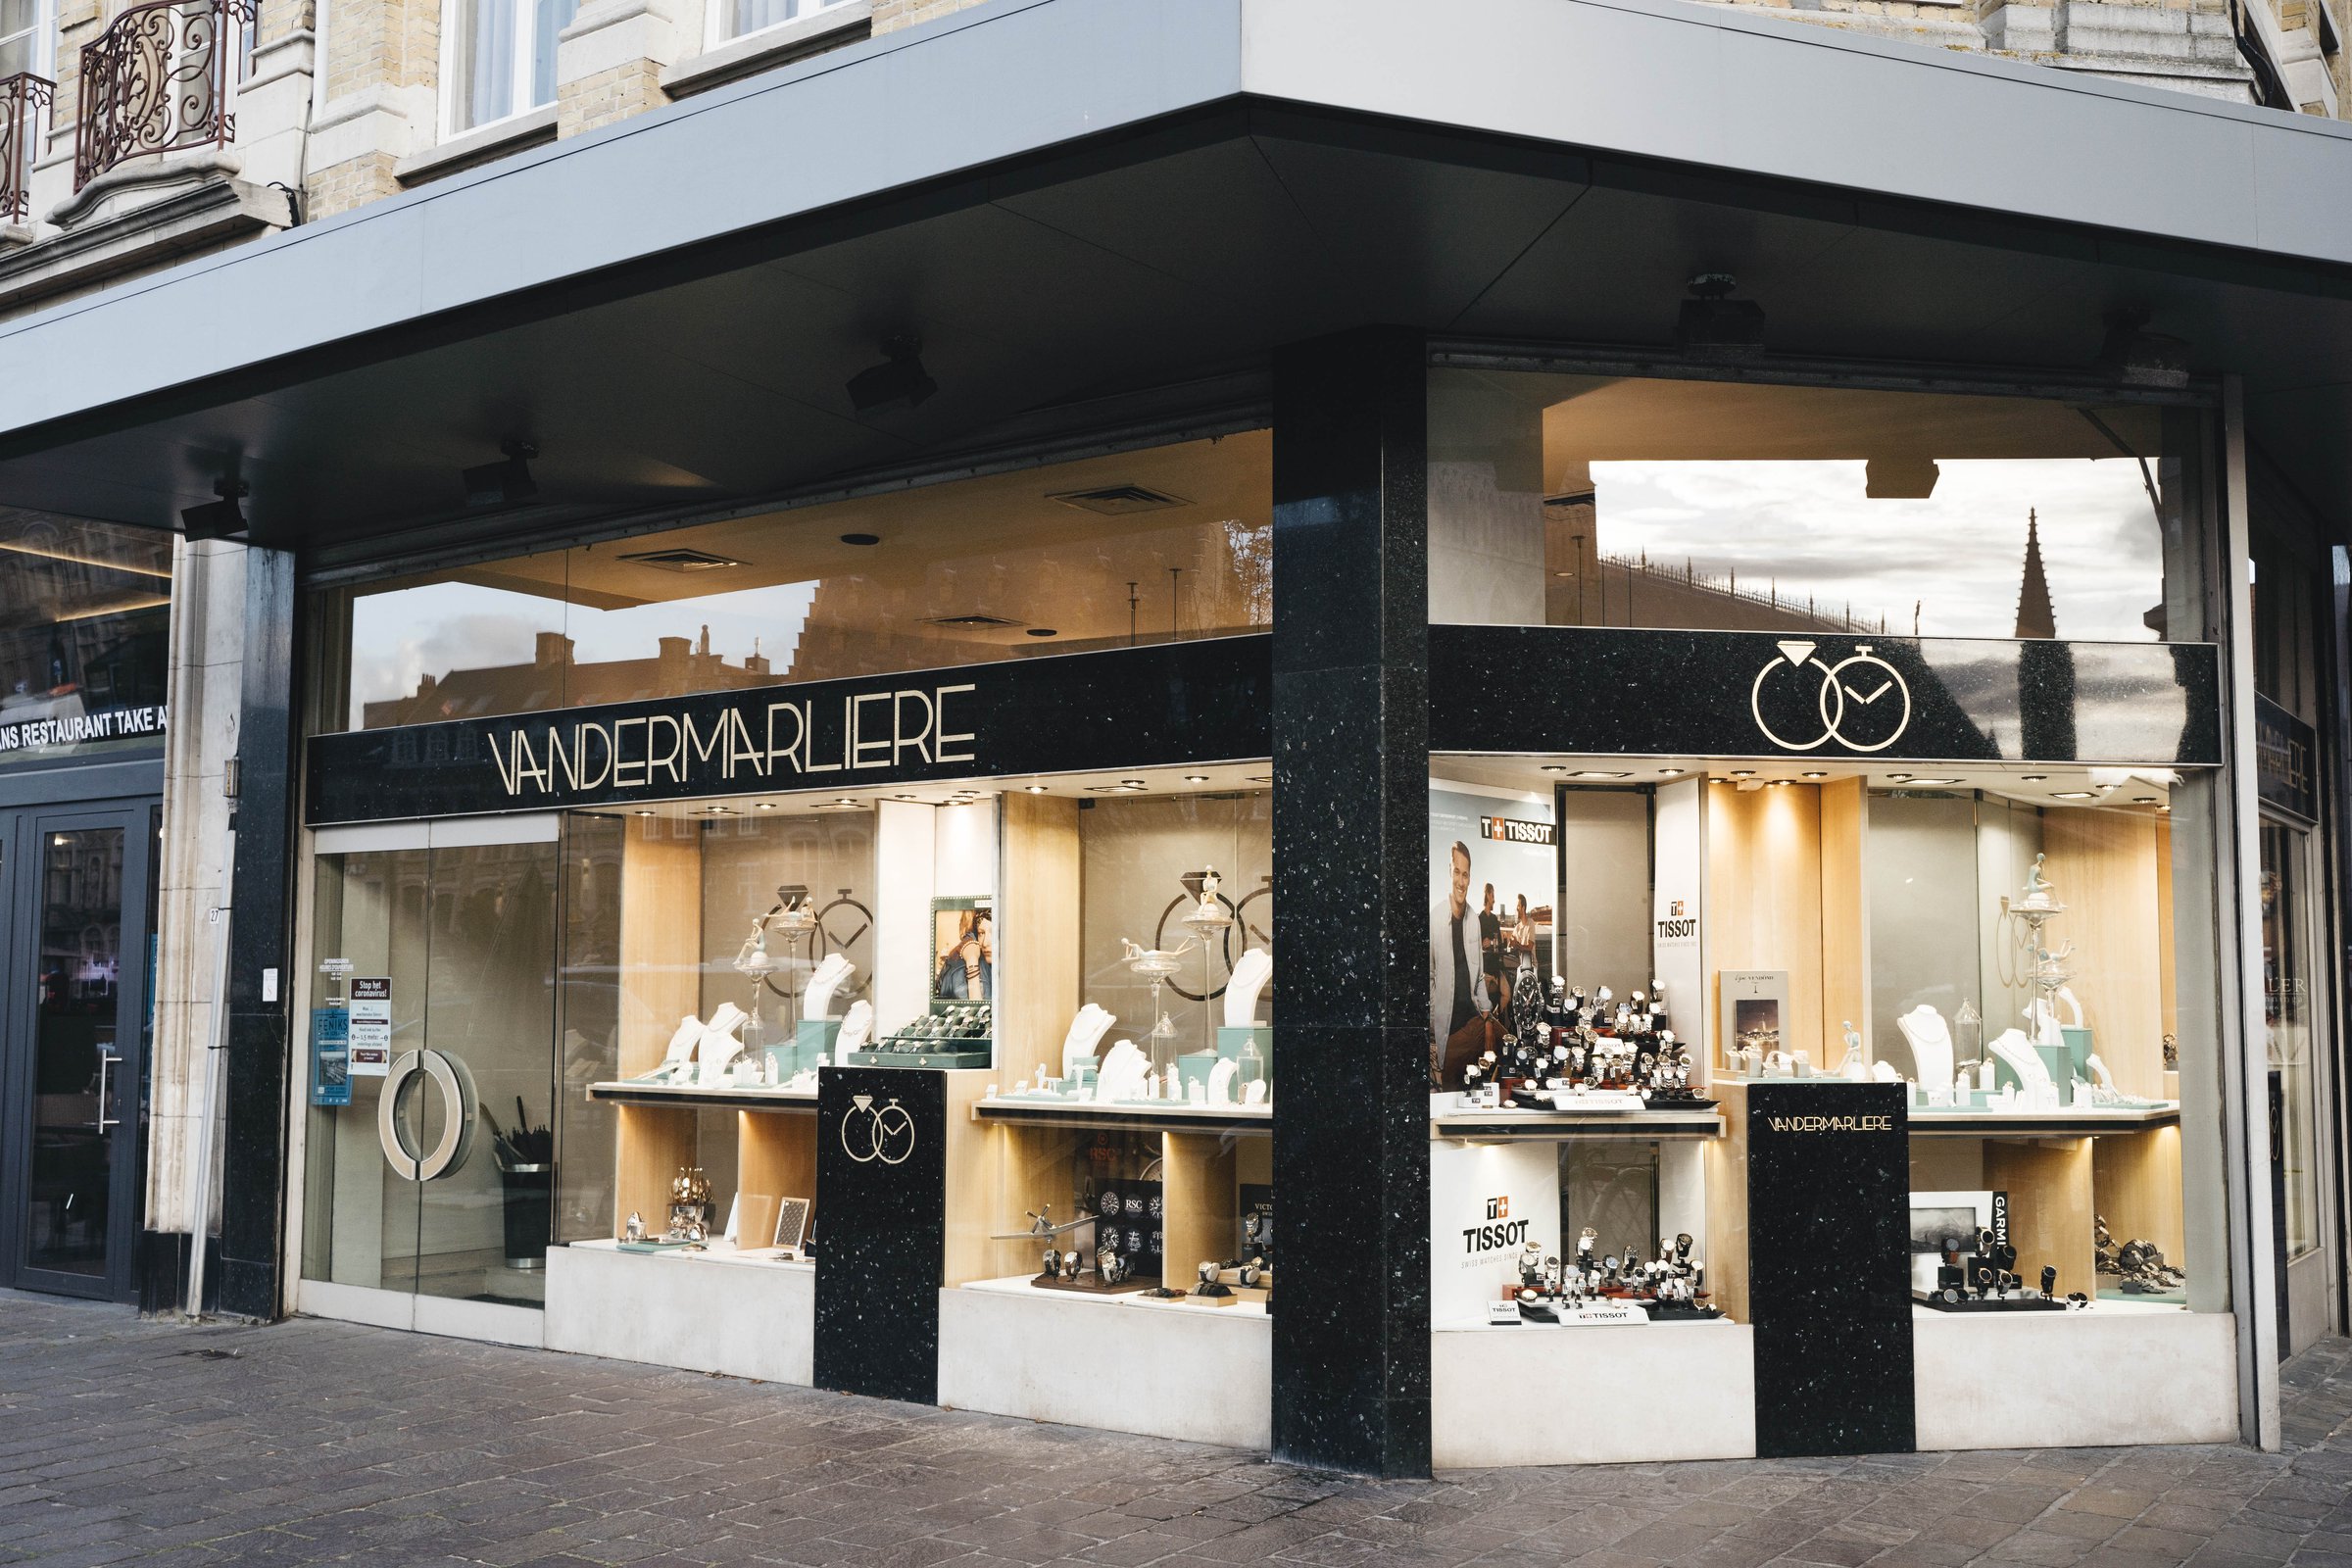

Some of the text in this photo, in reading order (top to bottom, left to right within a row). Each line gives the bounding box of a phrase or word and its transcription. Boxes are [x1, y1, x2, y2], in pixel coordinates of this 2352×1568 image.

[22, 713, 113, 747] RESTAURANT
[115, 708, 154, 734] TAKE
[157, 706, 168, 729] A
[488, 684, 976, 795] VANDERMARLIERE
[1505, 821, 1551, 843] TISSOT
[211, 909, 220, 922] 27
[1658, 919, 1696, 938] TISSOT
[355, 989, 387, 998] coronavirus!
[359, 980, 381, 991] Stop het
[318, 1019, 347, 1031] FENIKS
[1768, 1116, 1891, 1131] VANDERMARLIERE
[1125, 1199, 1143, 1209] RSC
[1995, 1196, 2007, 1250] GARMI
[1463, 1220, 1529, 1253] TISSOT
